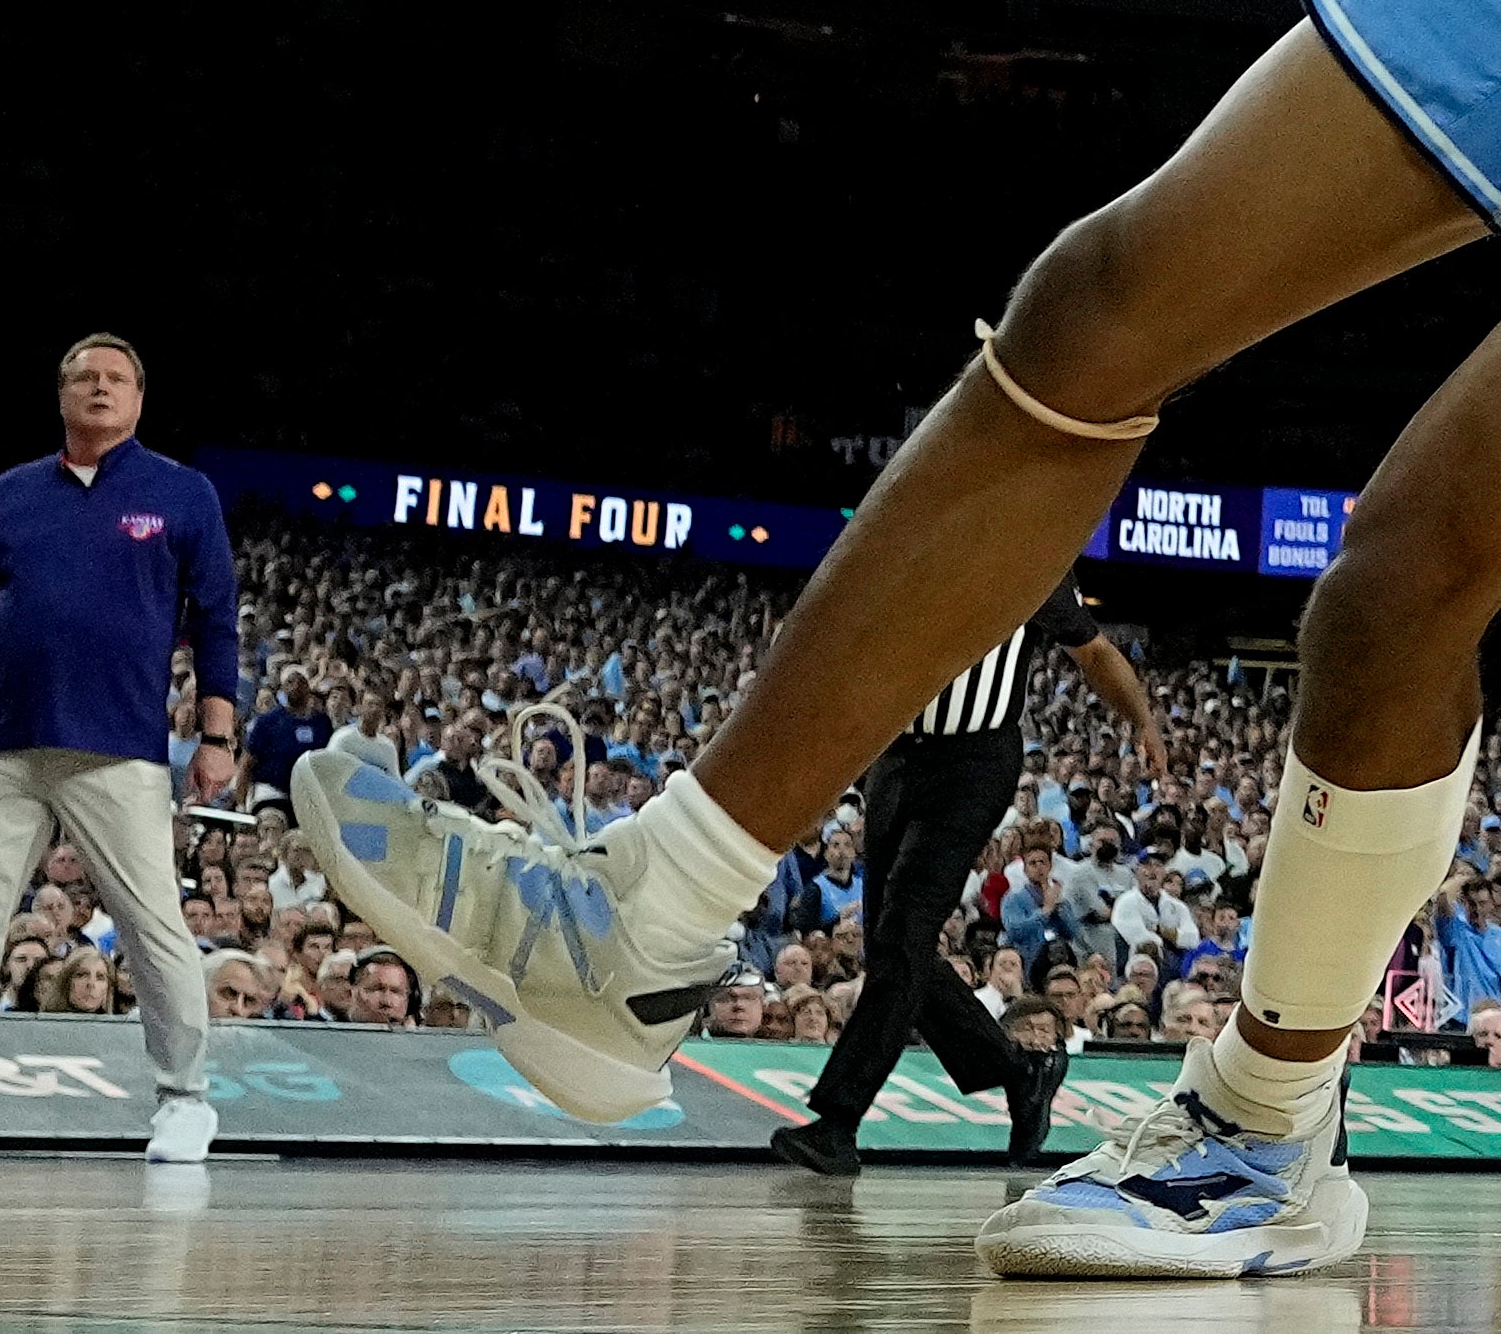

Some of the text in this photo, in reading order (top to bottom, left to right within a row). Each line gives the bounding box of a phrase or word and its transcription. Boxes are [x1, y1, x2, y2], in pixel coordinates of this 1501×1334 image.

[393, 474, 694, 550] FINAL FOUR
[1137, 487, 1222, 528] NORTH
[1118, 519, 1241, 562] CAROLINA
